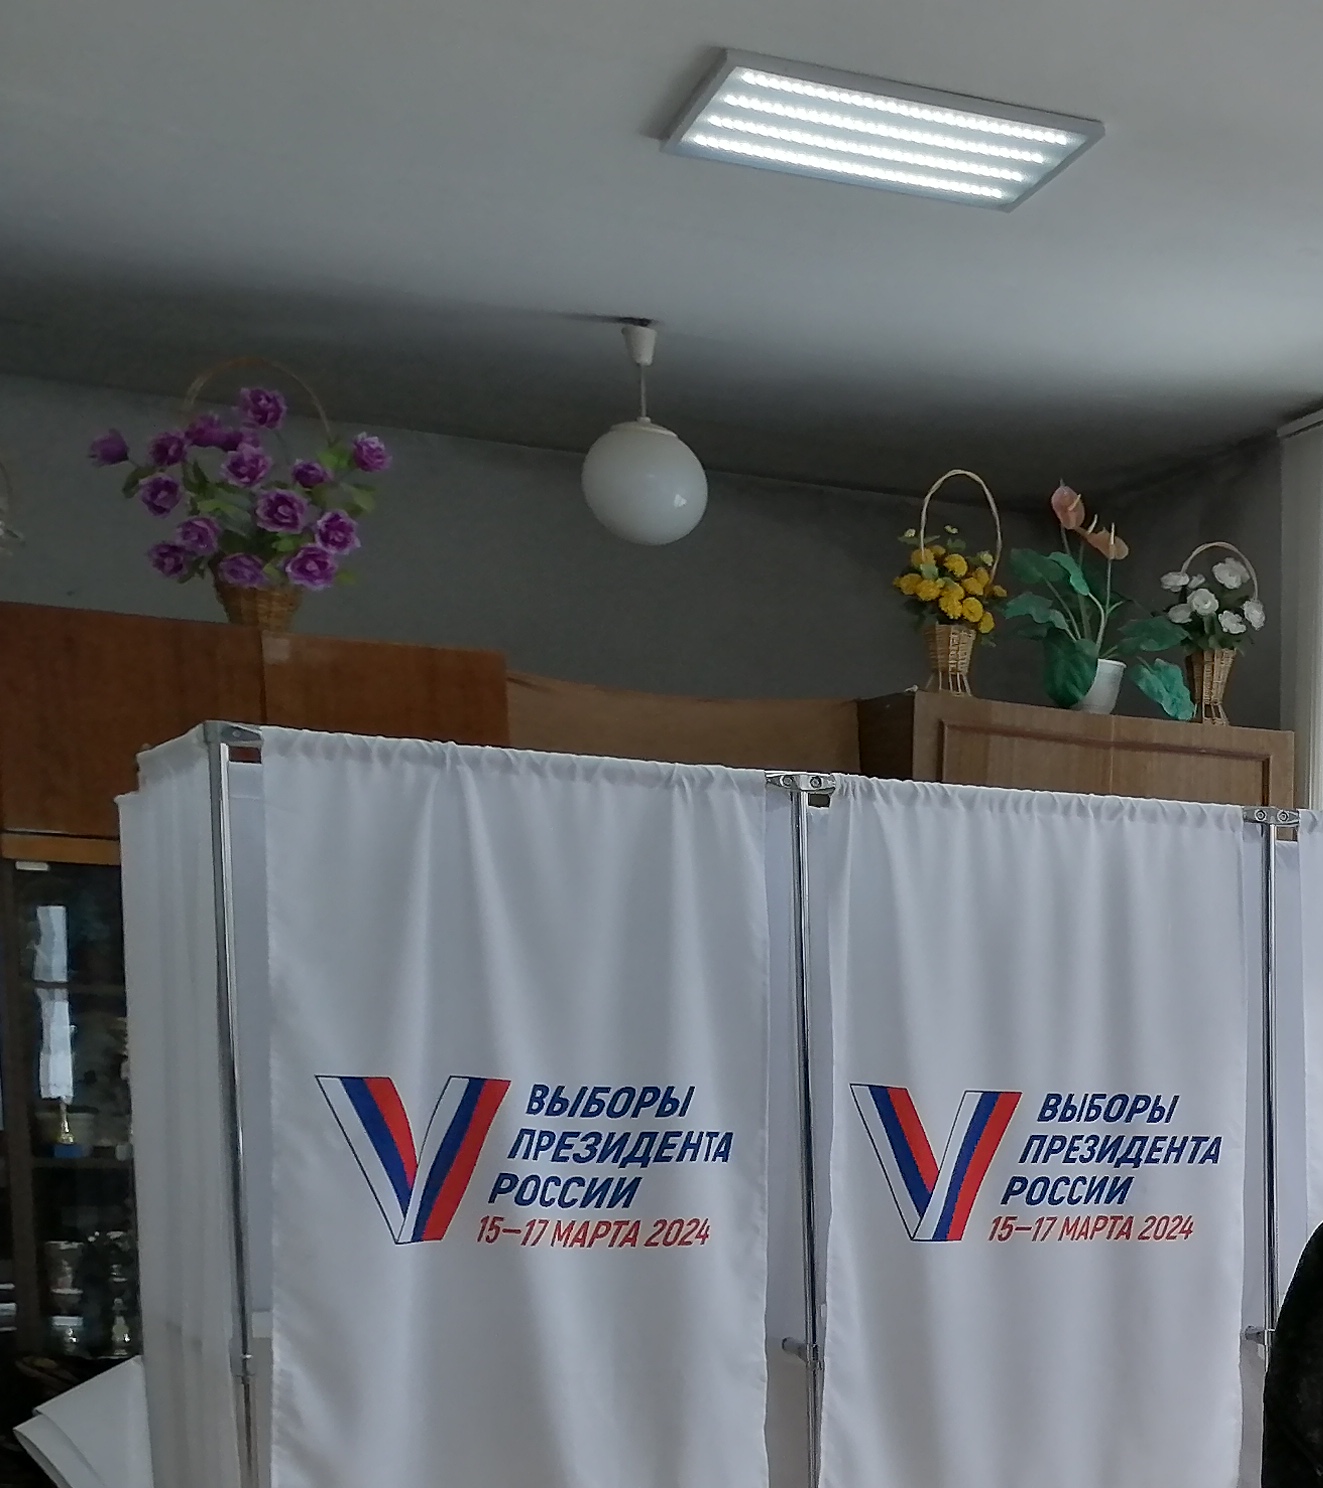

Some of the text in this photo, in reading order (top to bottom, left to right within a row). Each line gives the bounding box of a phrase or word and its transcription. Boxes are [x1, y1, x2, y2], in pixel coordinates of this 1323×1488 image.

[525, 1083, 695, 1119] ВЫБОРЫ
[1037, 1092, 1180, 1124] ВЫБОРЫ
[507, 1127, 733, 1169] ПРЕЗИДЕНТА
[1018, 1134, 1223, 1169] ПРЕЗИДЕНТА
[488, 1172, 641, 1209] РОССИИ
[1001, 1175, 1135, 1207] РОССИИ
[551, 1218, 640, 1249] МАРТА
[643, 1217, 711, 1248] 2024
[1058, 1215, 1134, 1242] МАРТА
[1137, 1215, 1195, 1242] 2024
